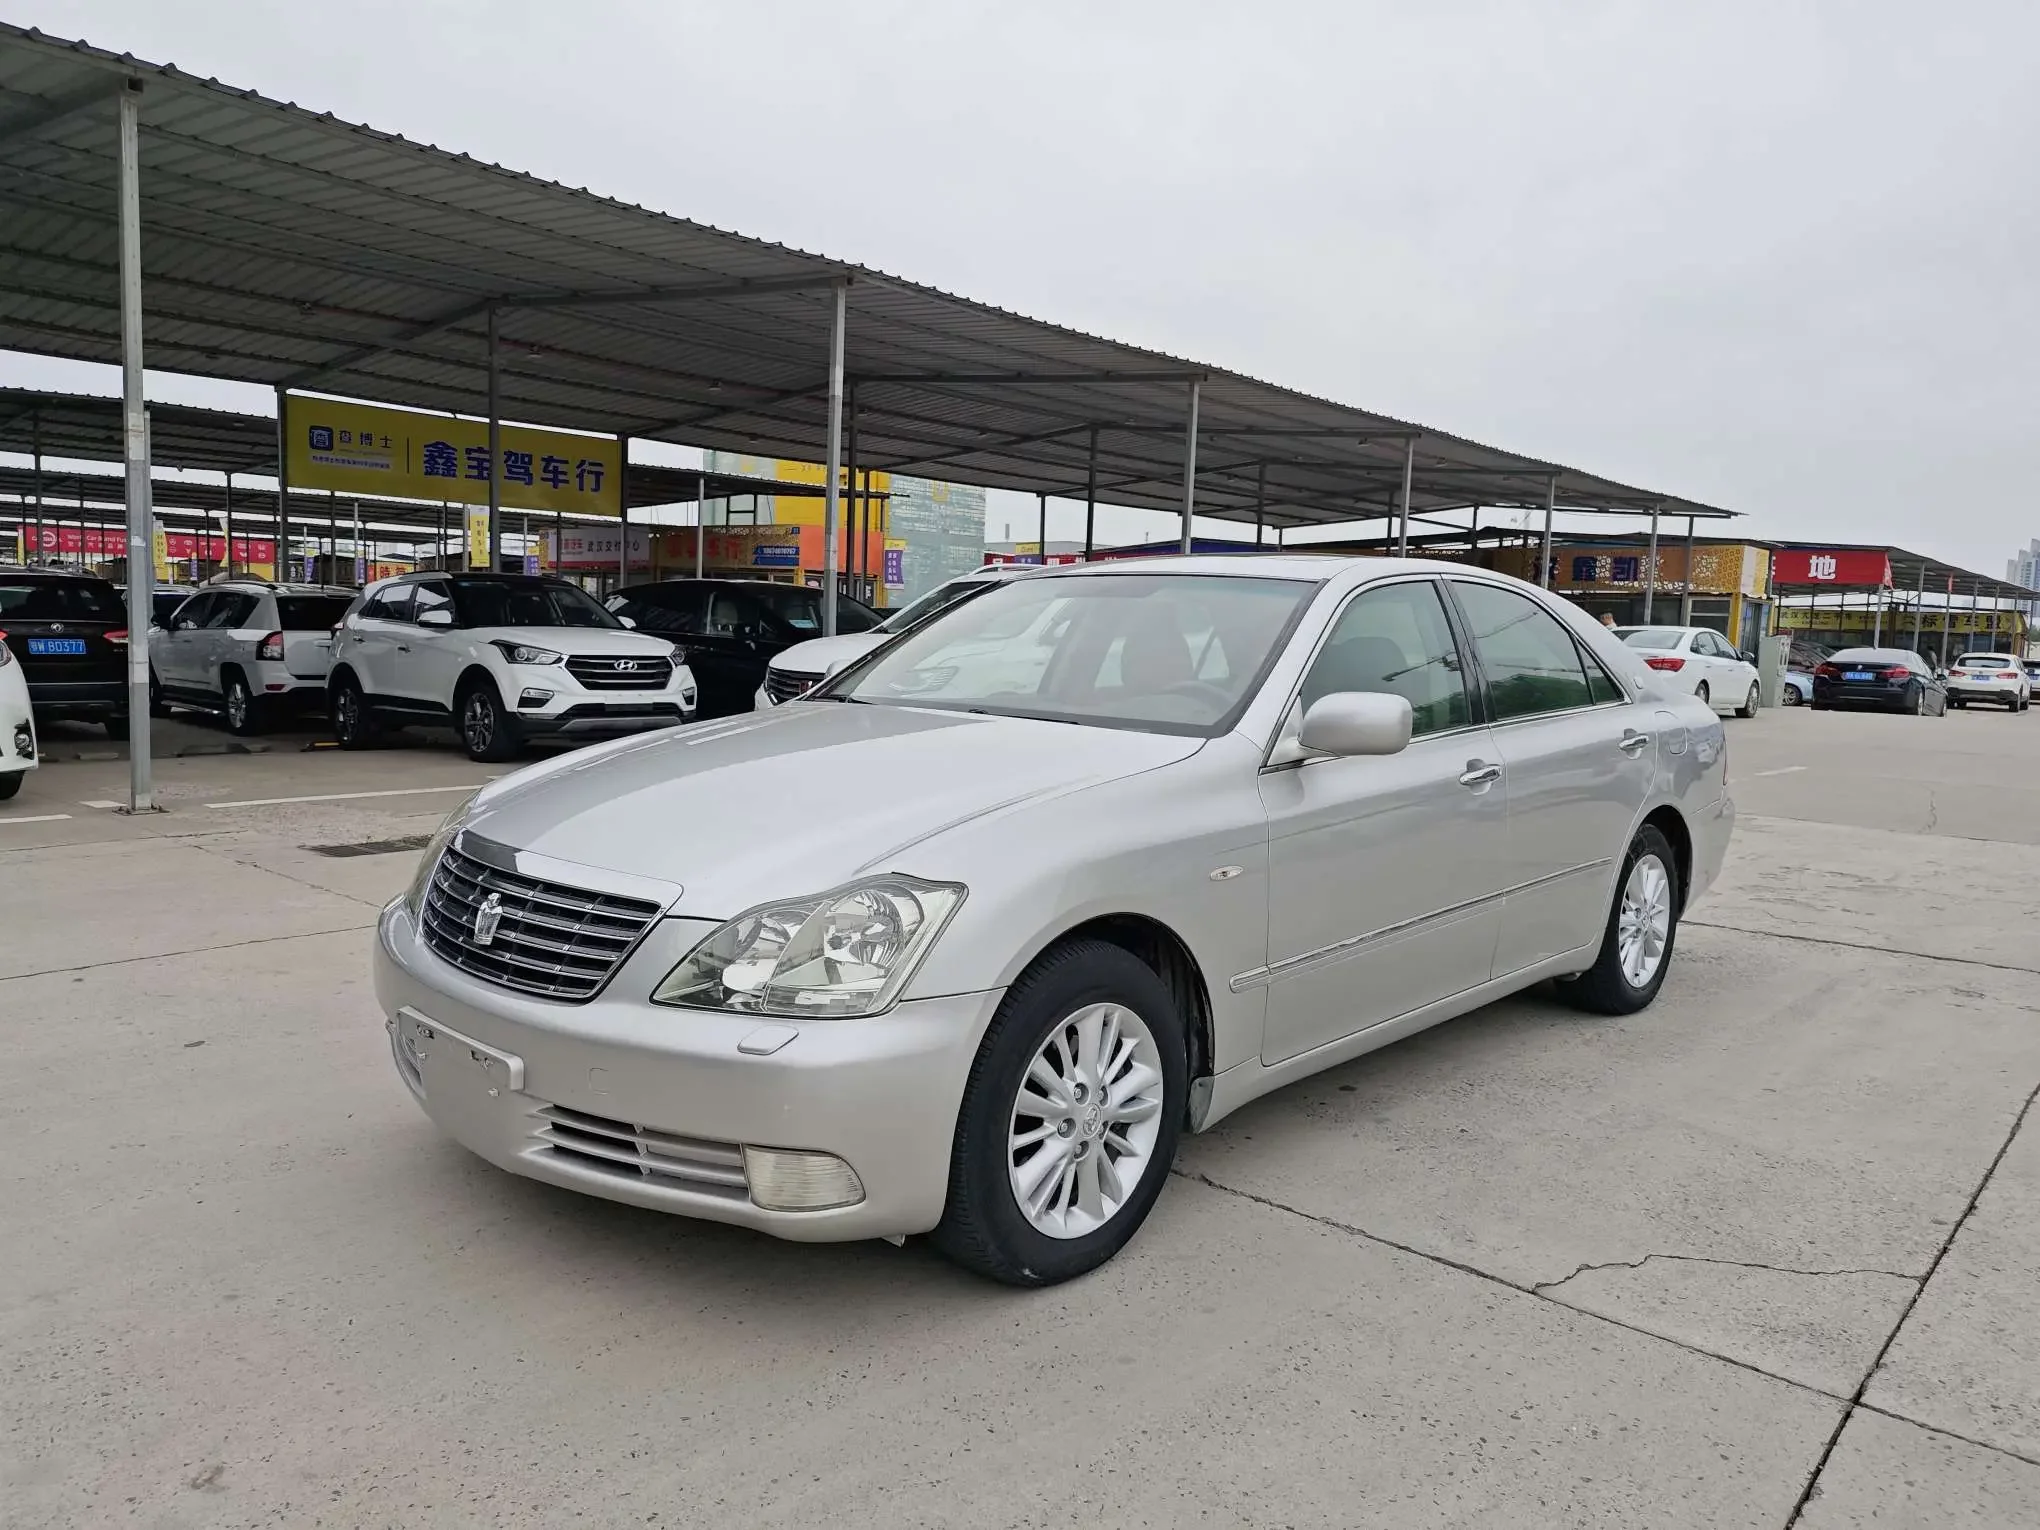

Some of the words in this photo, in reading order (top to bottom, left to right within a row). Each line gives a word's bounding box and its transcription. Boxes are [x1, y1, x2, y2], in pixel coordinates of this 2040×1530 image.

[423, 440, 605, 492] 鑫宝驾车行
[1807, 554, 1837, 580] 地
